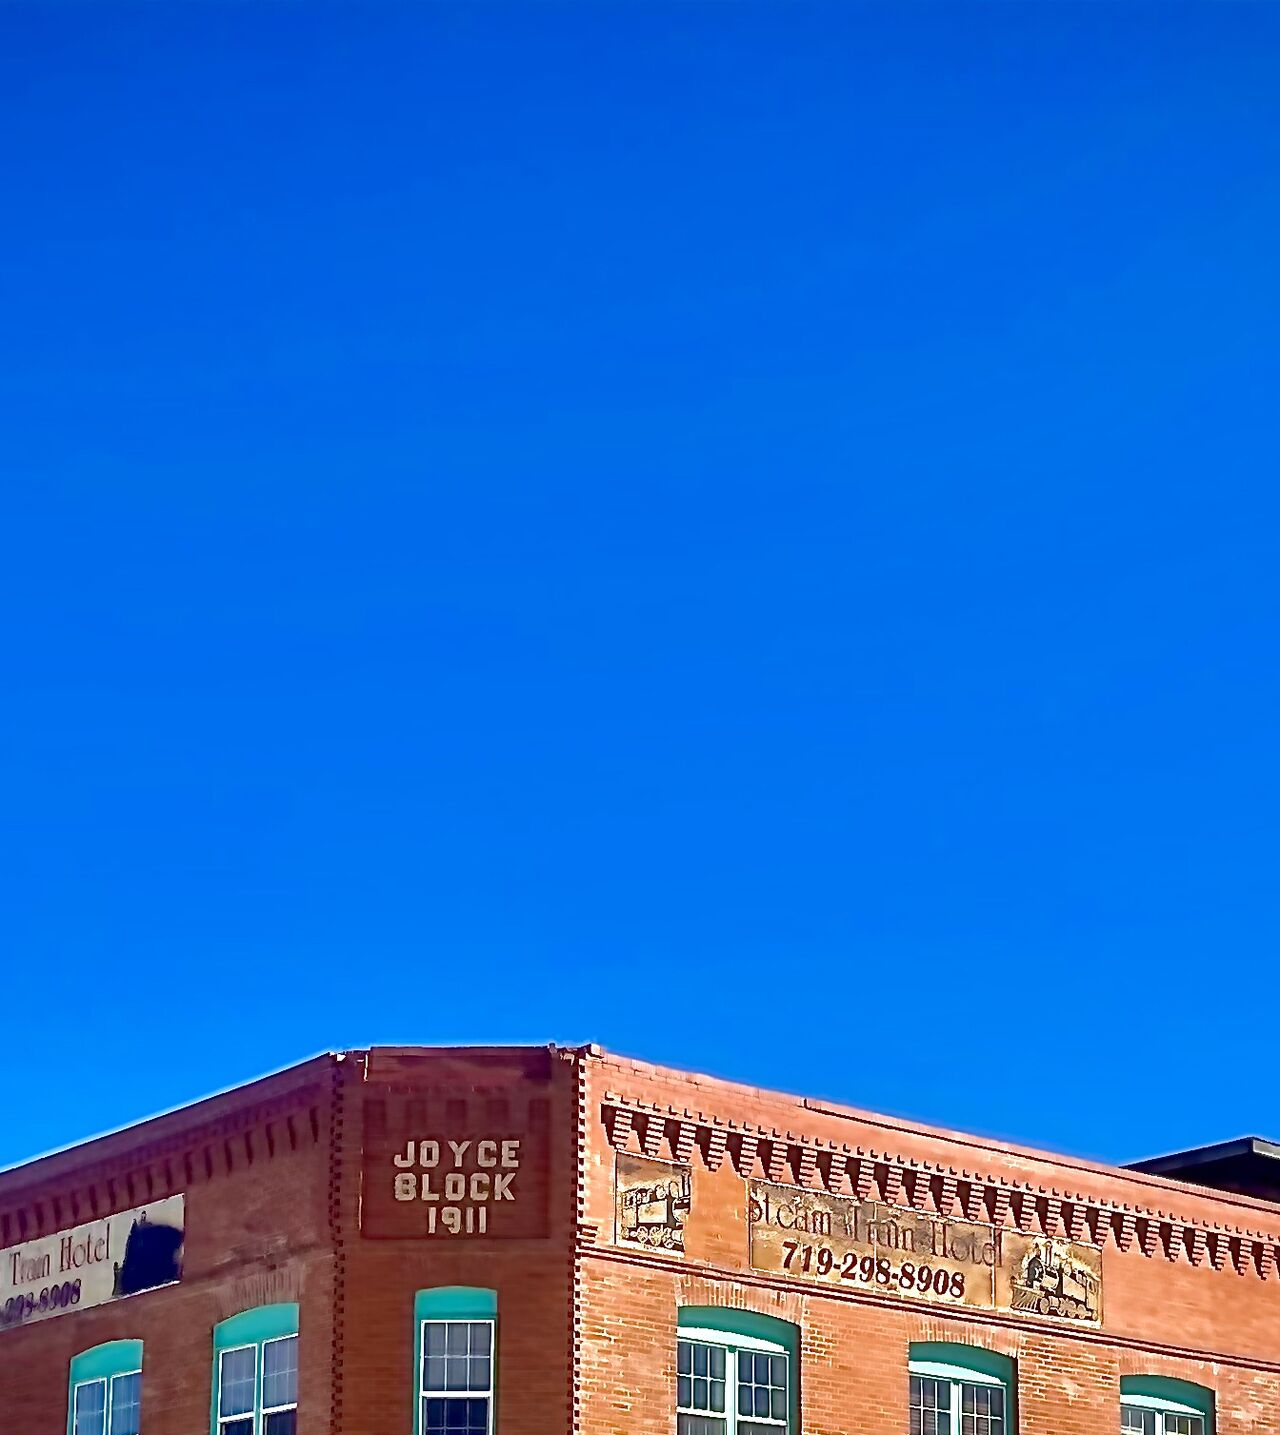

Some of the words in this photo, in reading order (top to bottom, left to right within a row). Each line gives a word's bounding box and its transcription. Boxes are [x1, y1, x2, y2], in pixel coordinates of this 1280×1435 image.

[393, 1140, 520, 1168] JOYCE
[394, 1172, 516, 1201] BLOCK
[427, 1205, 487, 1234] 1911
[749, 1191, 833, 1237] Steam
[844, 1200, 917, 1252] Train
[930, 1216, 1003, 1267] Hotel
[9, 1249, 51, 1286] Train
[59, 1222, 111, 1273] Hotel
[782, 1241, 966, 1299] 719-298-8908
